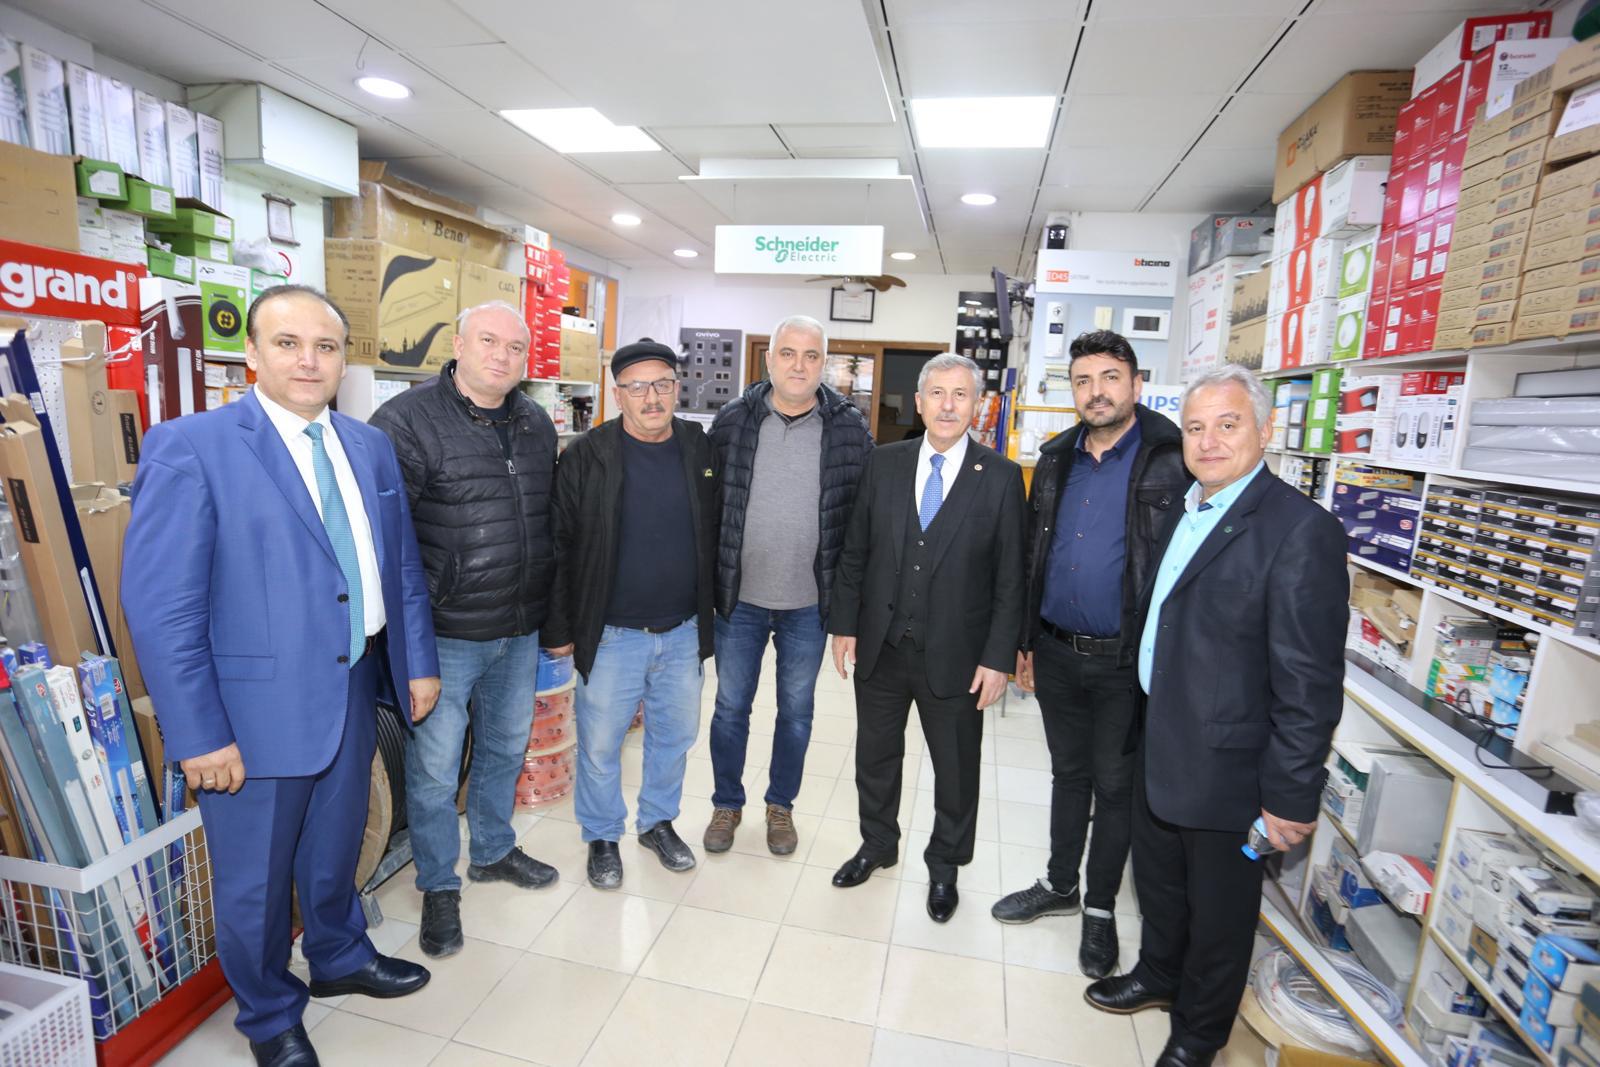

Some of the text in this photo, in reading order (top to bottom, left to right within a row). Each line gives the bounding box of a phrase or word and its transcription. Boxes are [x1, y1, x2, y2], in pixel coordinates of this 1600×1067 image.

[755, 236, 839, 252] Schneider
[790, 252, 837, 263] Electric
[1134, 258, 1171, 268] bticino
